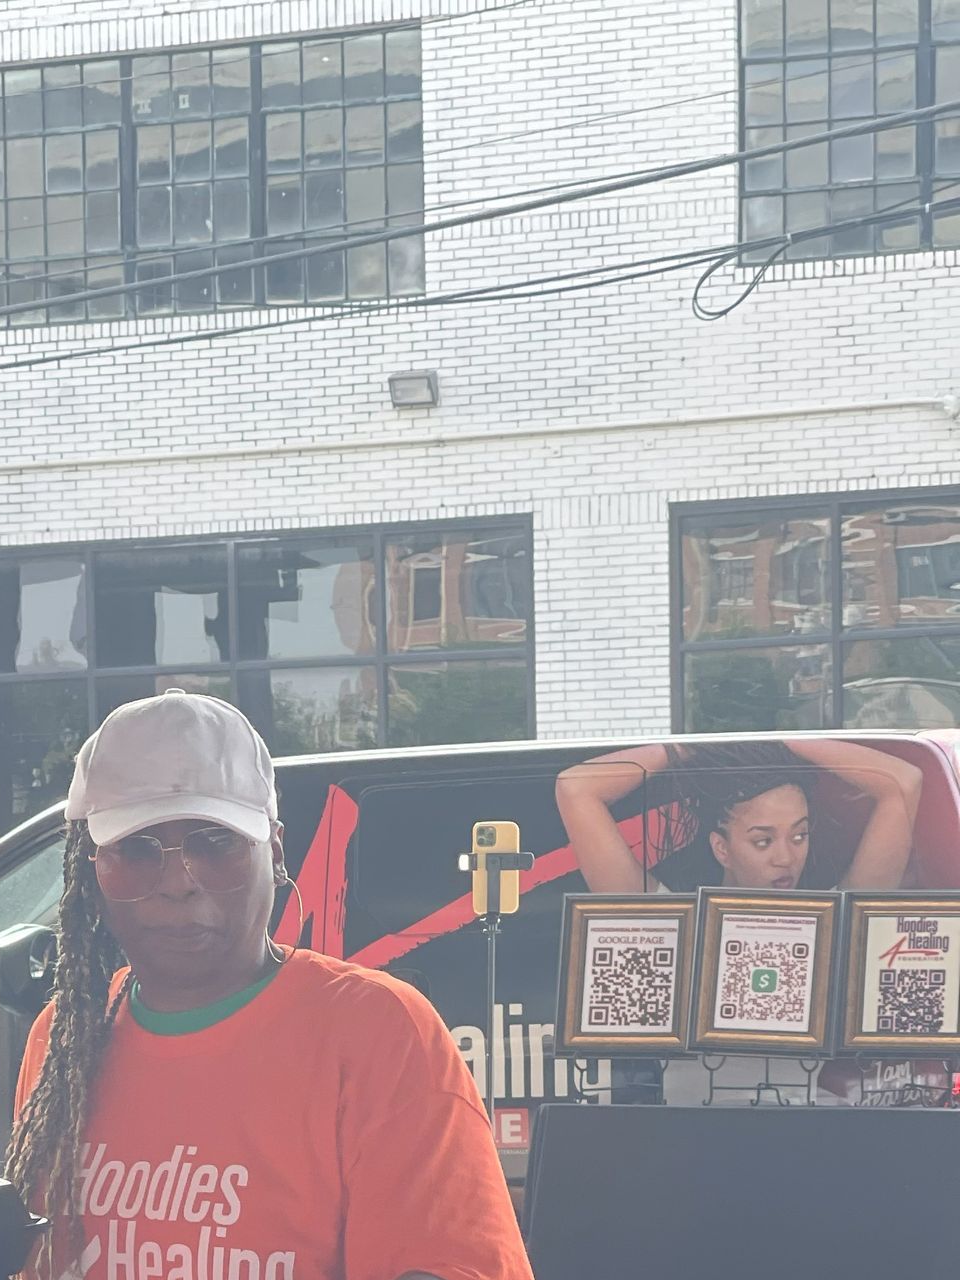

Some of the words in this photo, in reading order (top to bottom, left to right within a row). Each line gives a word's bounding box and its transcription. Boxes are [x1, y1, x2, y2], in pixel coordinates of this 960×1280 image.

[598, 935, 638, 945] GOOGLE
[640, 936, 665, 945] PAGE
[908, 932, 949, 953] Healing
[451, 1003, 612, 1105] alin
[63, 1143, 249, 1225] Hoodies
